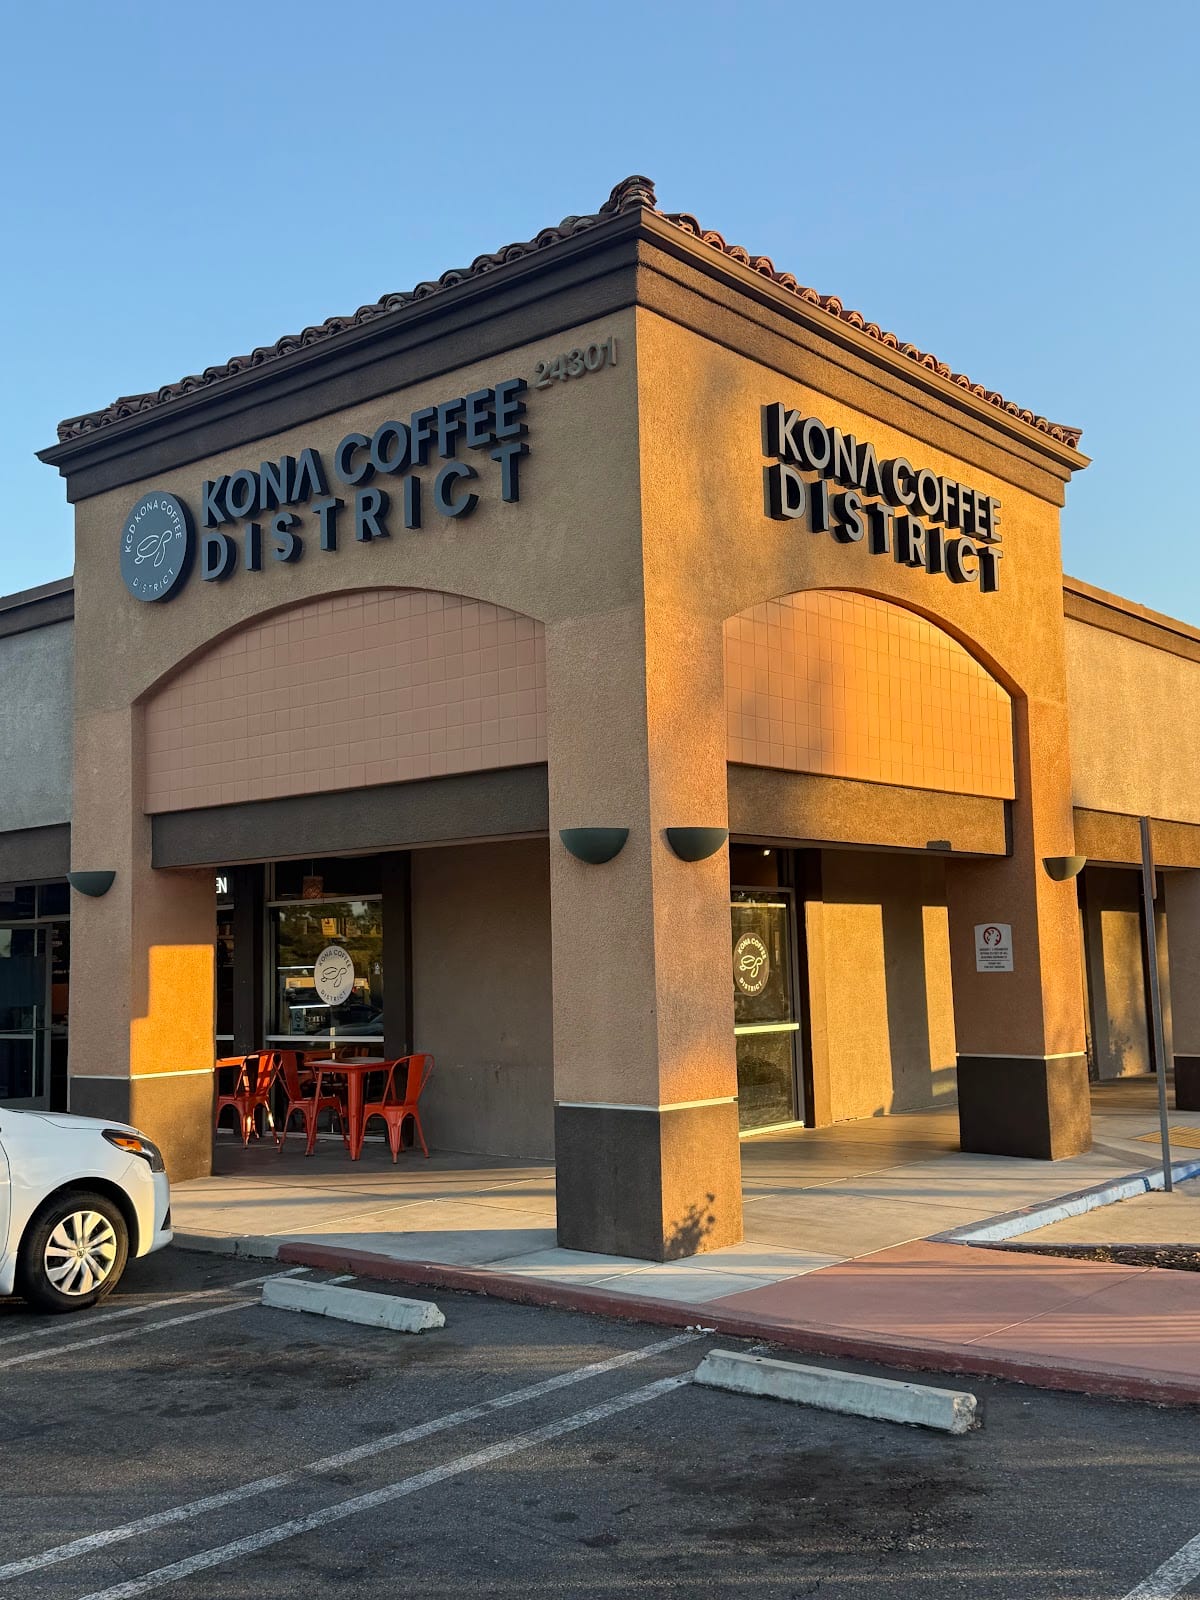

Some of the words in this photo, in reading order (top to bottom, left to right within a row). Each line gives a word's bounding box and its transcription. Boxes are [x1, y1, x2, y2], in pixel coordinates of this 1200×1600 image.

[528, 336, 616, 390] 24301
[201, 447, 330, 528] KONA
[334, 378, 528, 486] COFFEE
[764, 402, 883, 497] KONA
[882, 457, 1002, 543] COFFEE
[124, 524, 136, 553] KCD
[134, 499, 159, 523] KONA
[160, 500, 183, 540] COFFEE
[201, 442, 530, 582] DISTRICT
[765, 463, 1003, 593] DISTRICT
[132, 567, 175, 593] DISTRICT
[318, 950, 333, 967] KONA
[333, 949, 352, 968] COFFEE
[737, 937, 751, 955] KONA
[751, 937, 767, 960] COFFEE
[320, 989, 346, 1001] DISTRICT
[738, 977, 763, 992] DISTRICT
